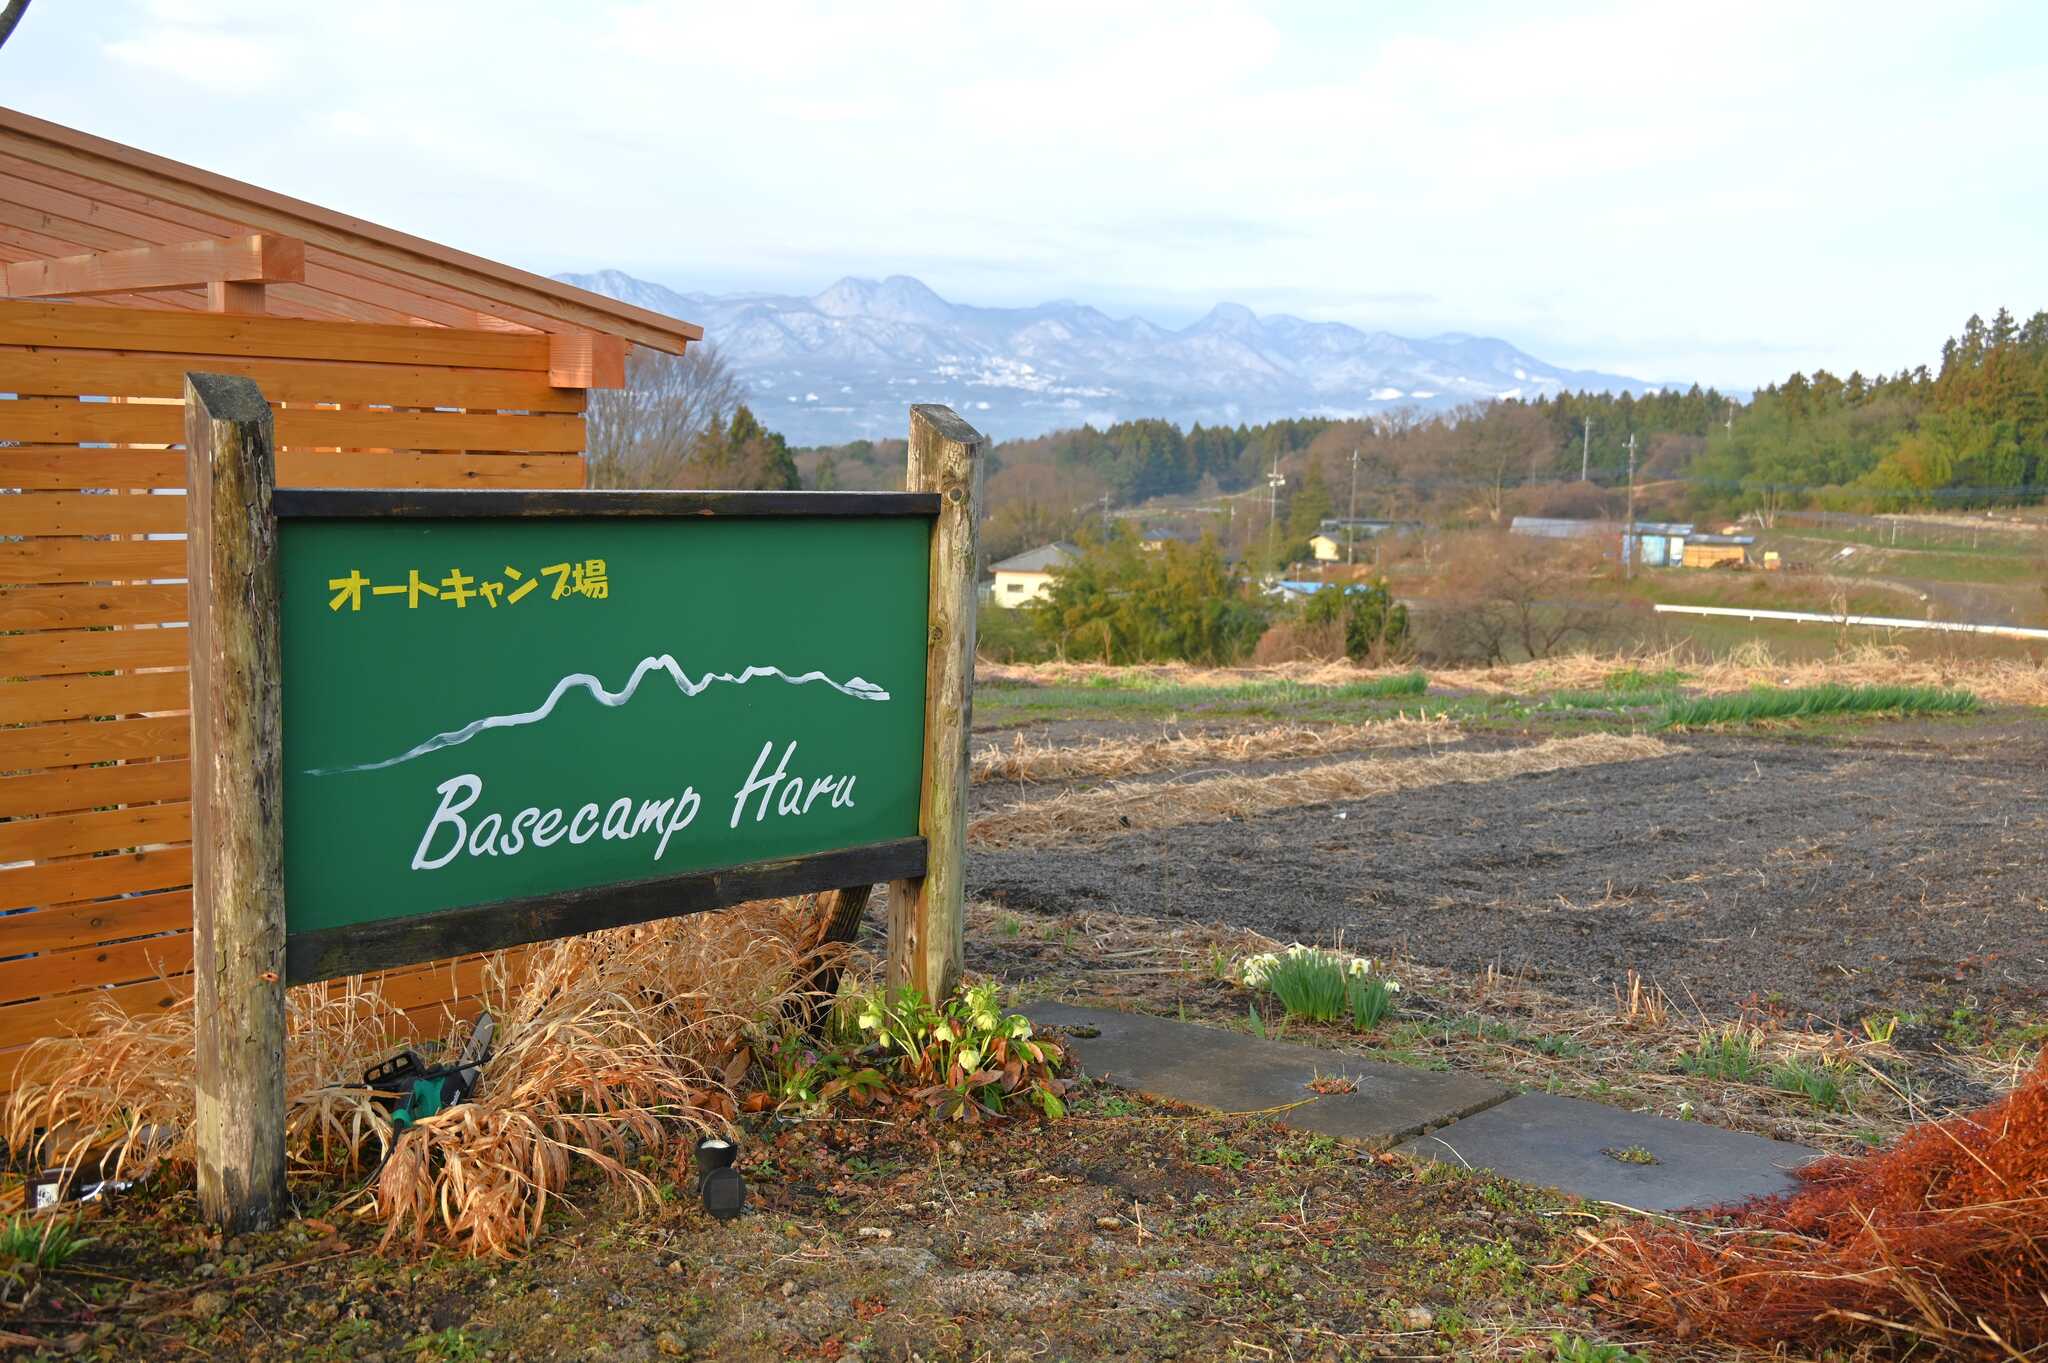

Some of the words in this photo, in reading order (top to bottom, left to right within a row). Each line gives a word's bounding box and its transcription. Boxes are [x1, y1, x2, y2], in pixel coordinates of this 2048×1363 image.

[328, 559, 609, 612] オートキャンプ場
[411, 773, 701, 870] Basecamp
[730, 740, 857, 829] Haru
